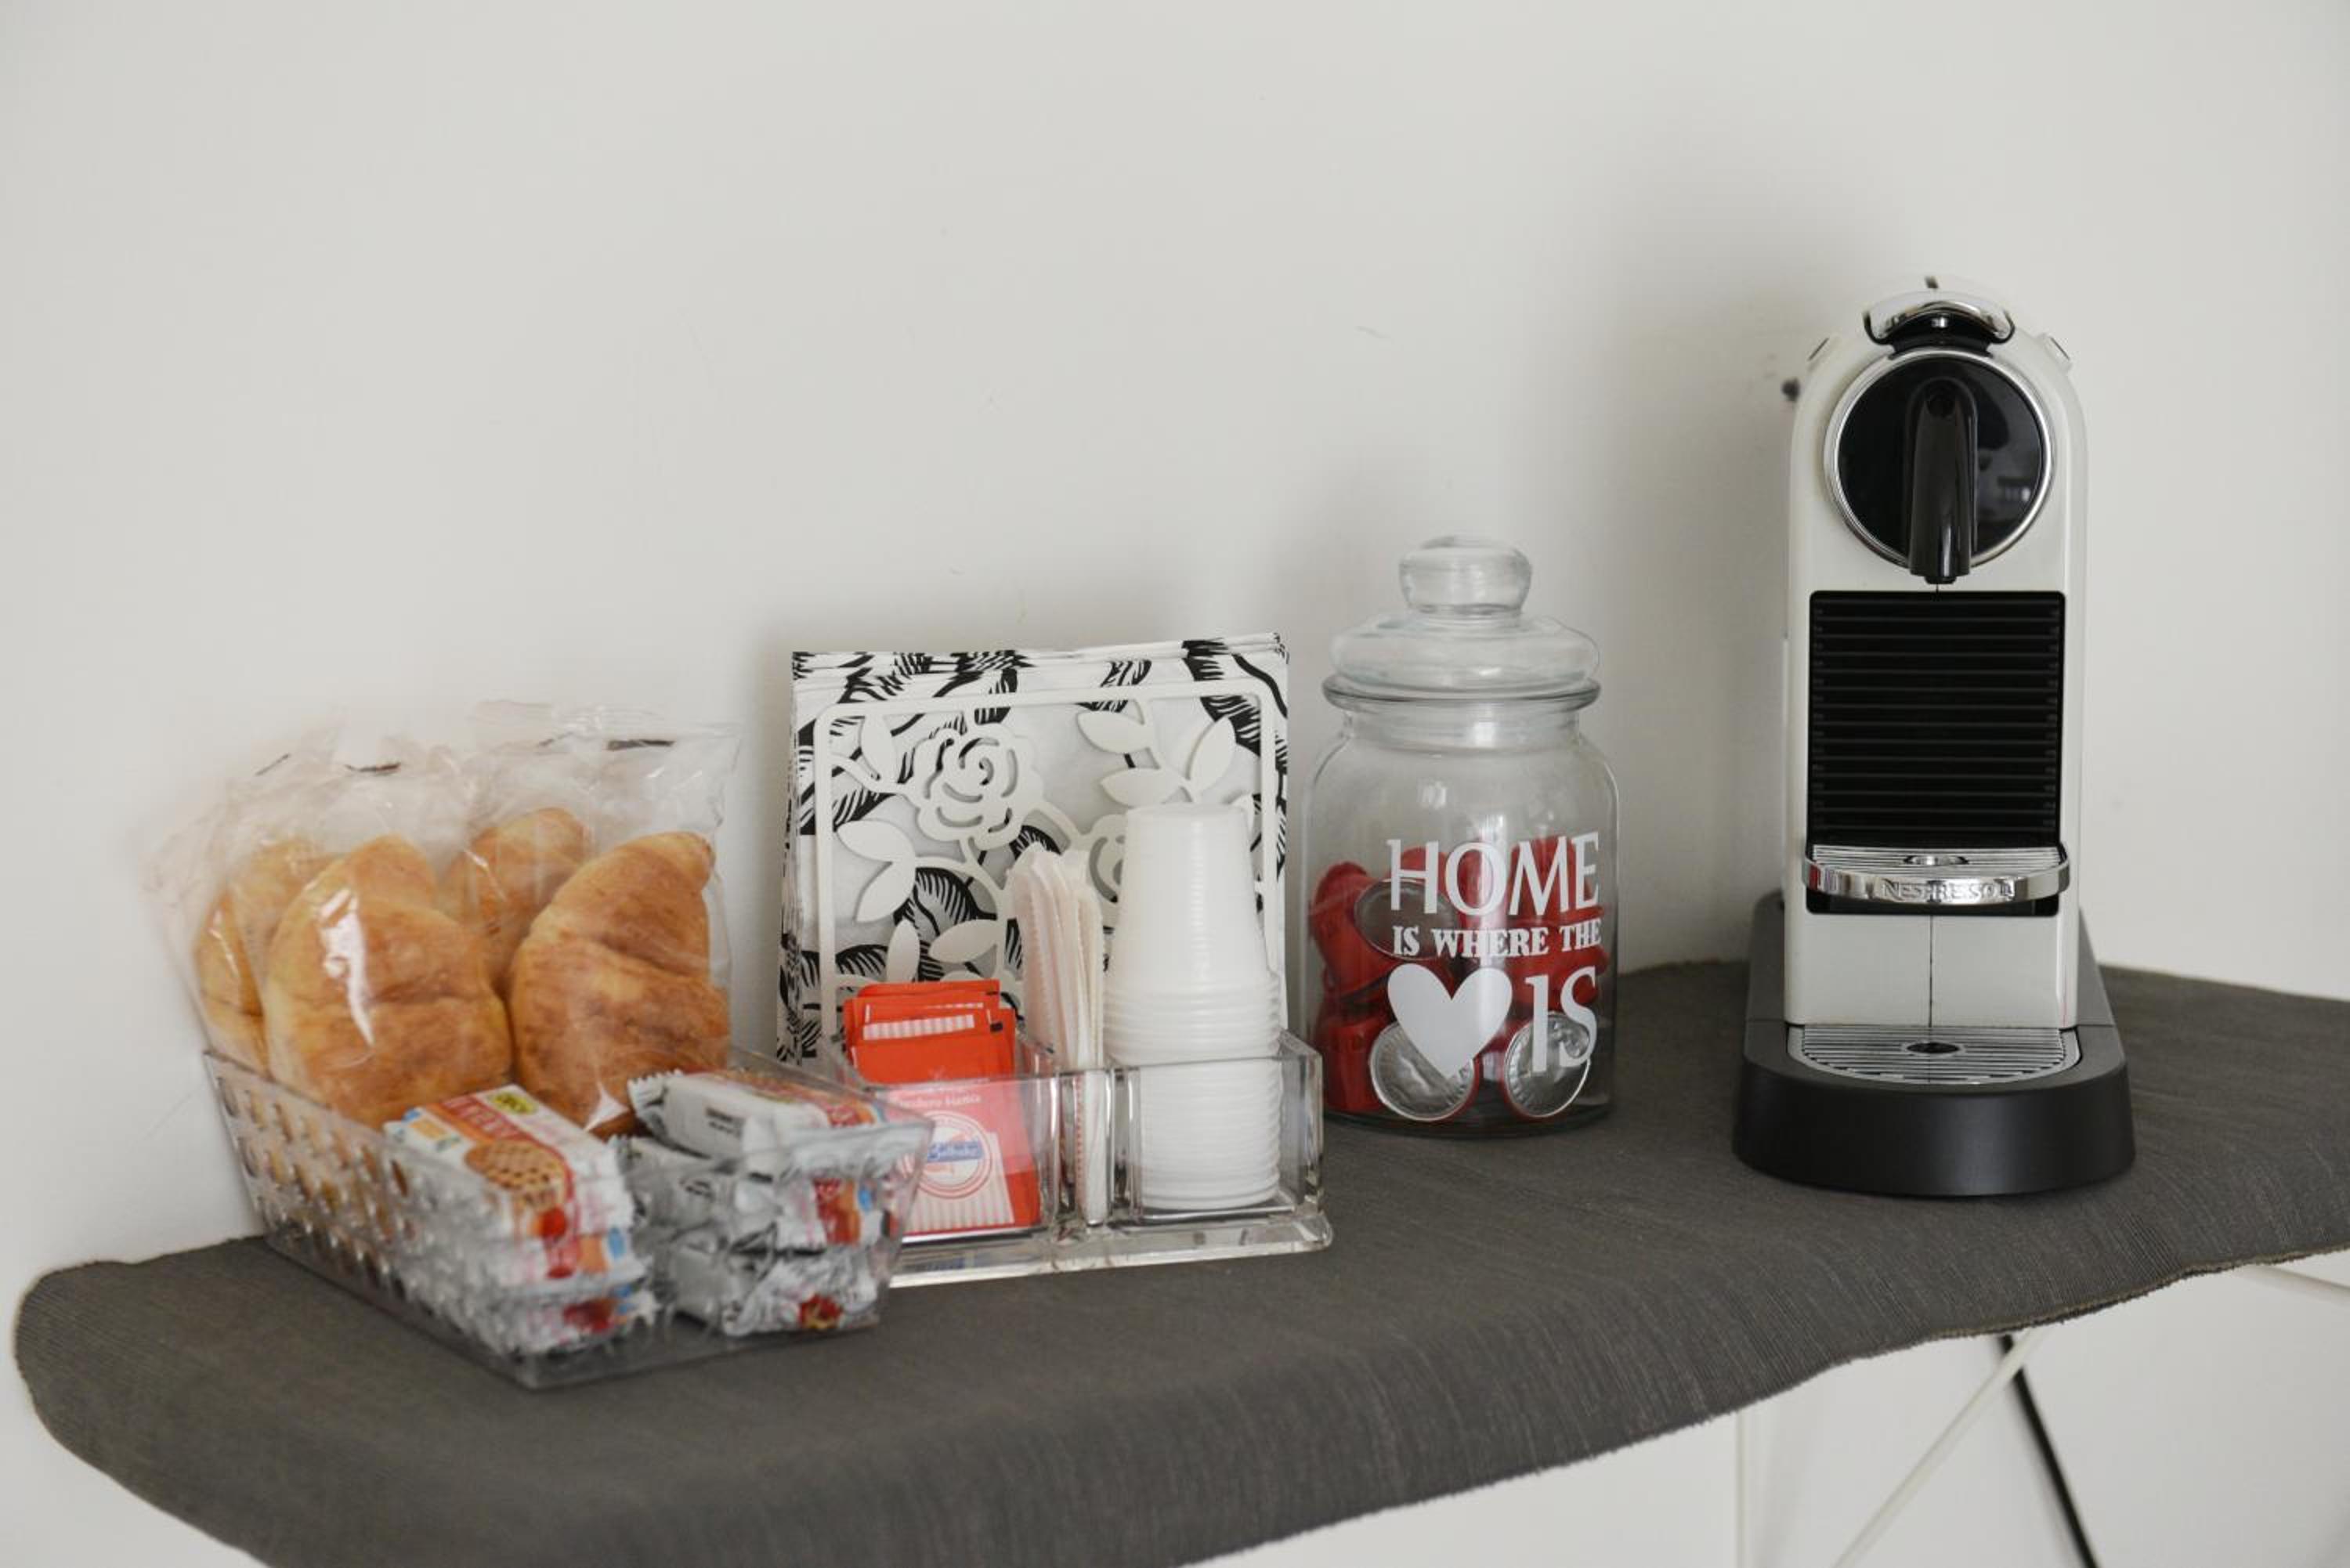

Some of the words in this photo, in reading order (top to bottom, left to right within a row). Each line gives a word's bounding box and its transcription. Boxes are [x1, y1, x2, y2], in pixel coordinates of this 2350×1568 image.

[1386, 832, 1599, 916] HOME
[1391, 924, 1420, 956] IS
[1430, 927, 1549, 958] WHERE
[1559, 917, 1603, 952] THE
[1525, 966, 1597, 1073] IS
